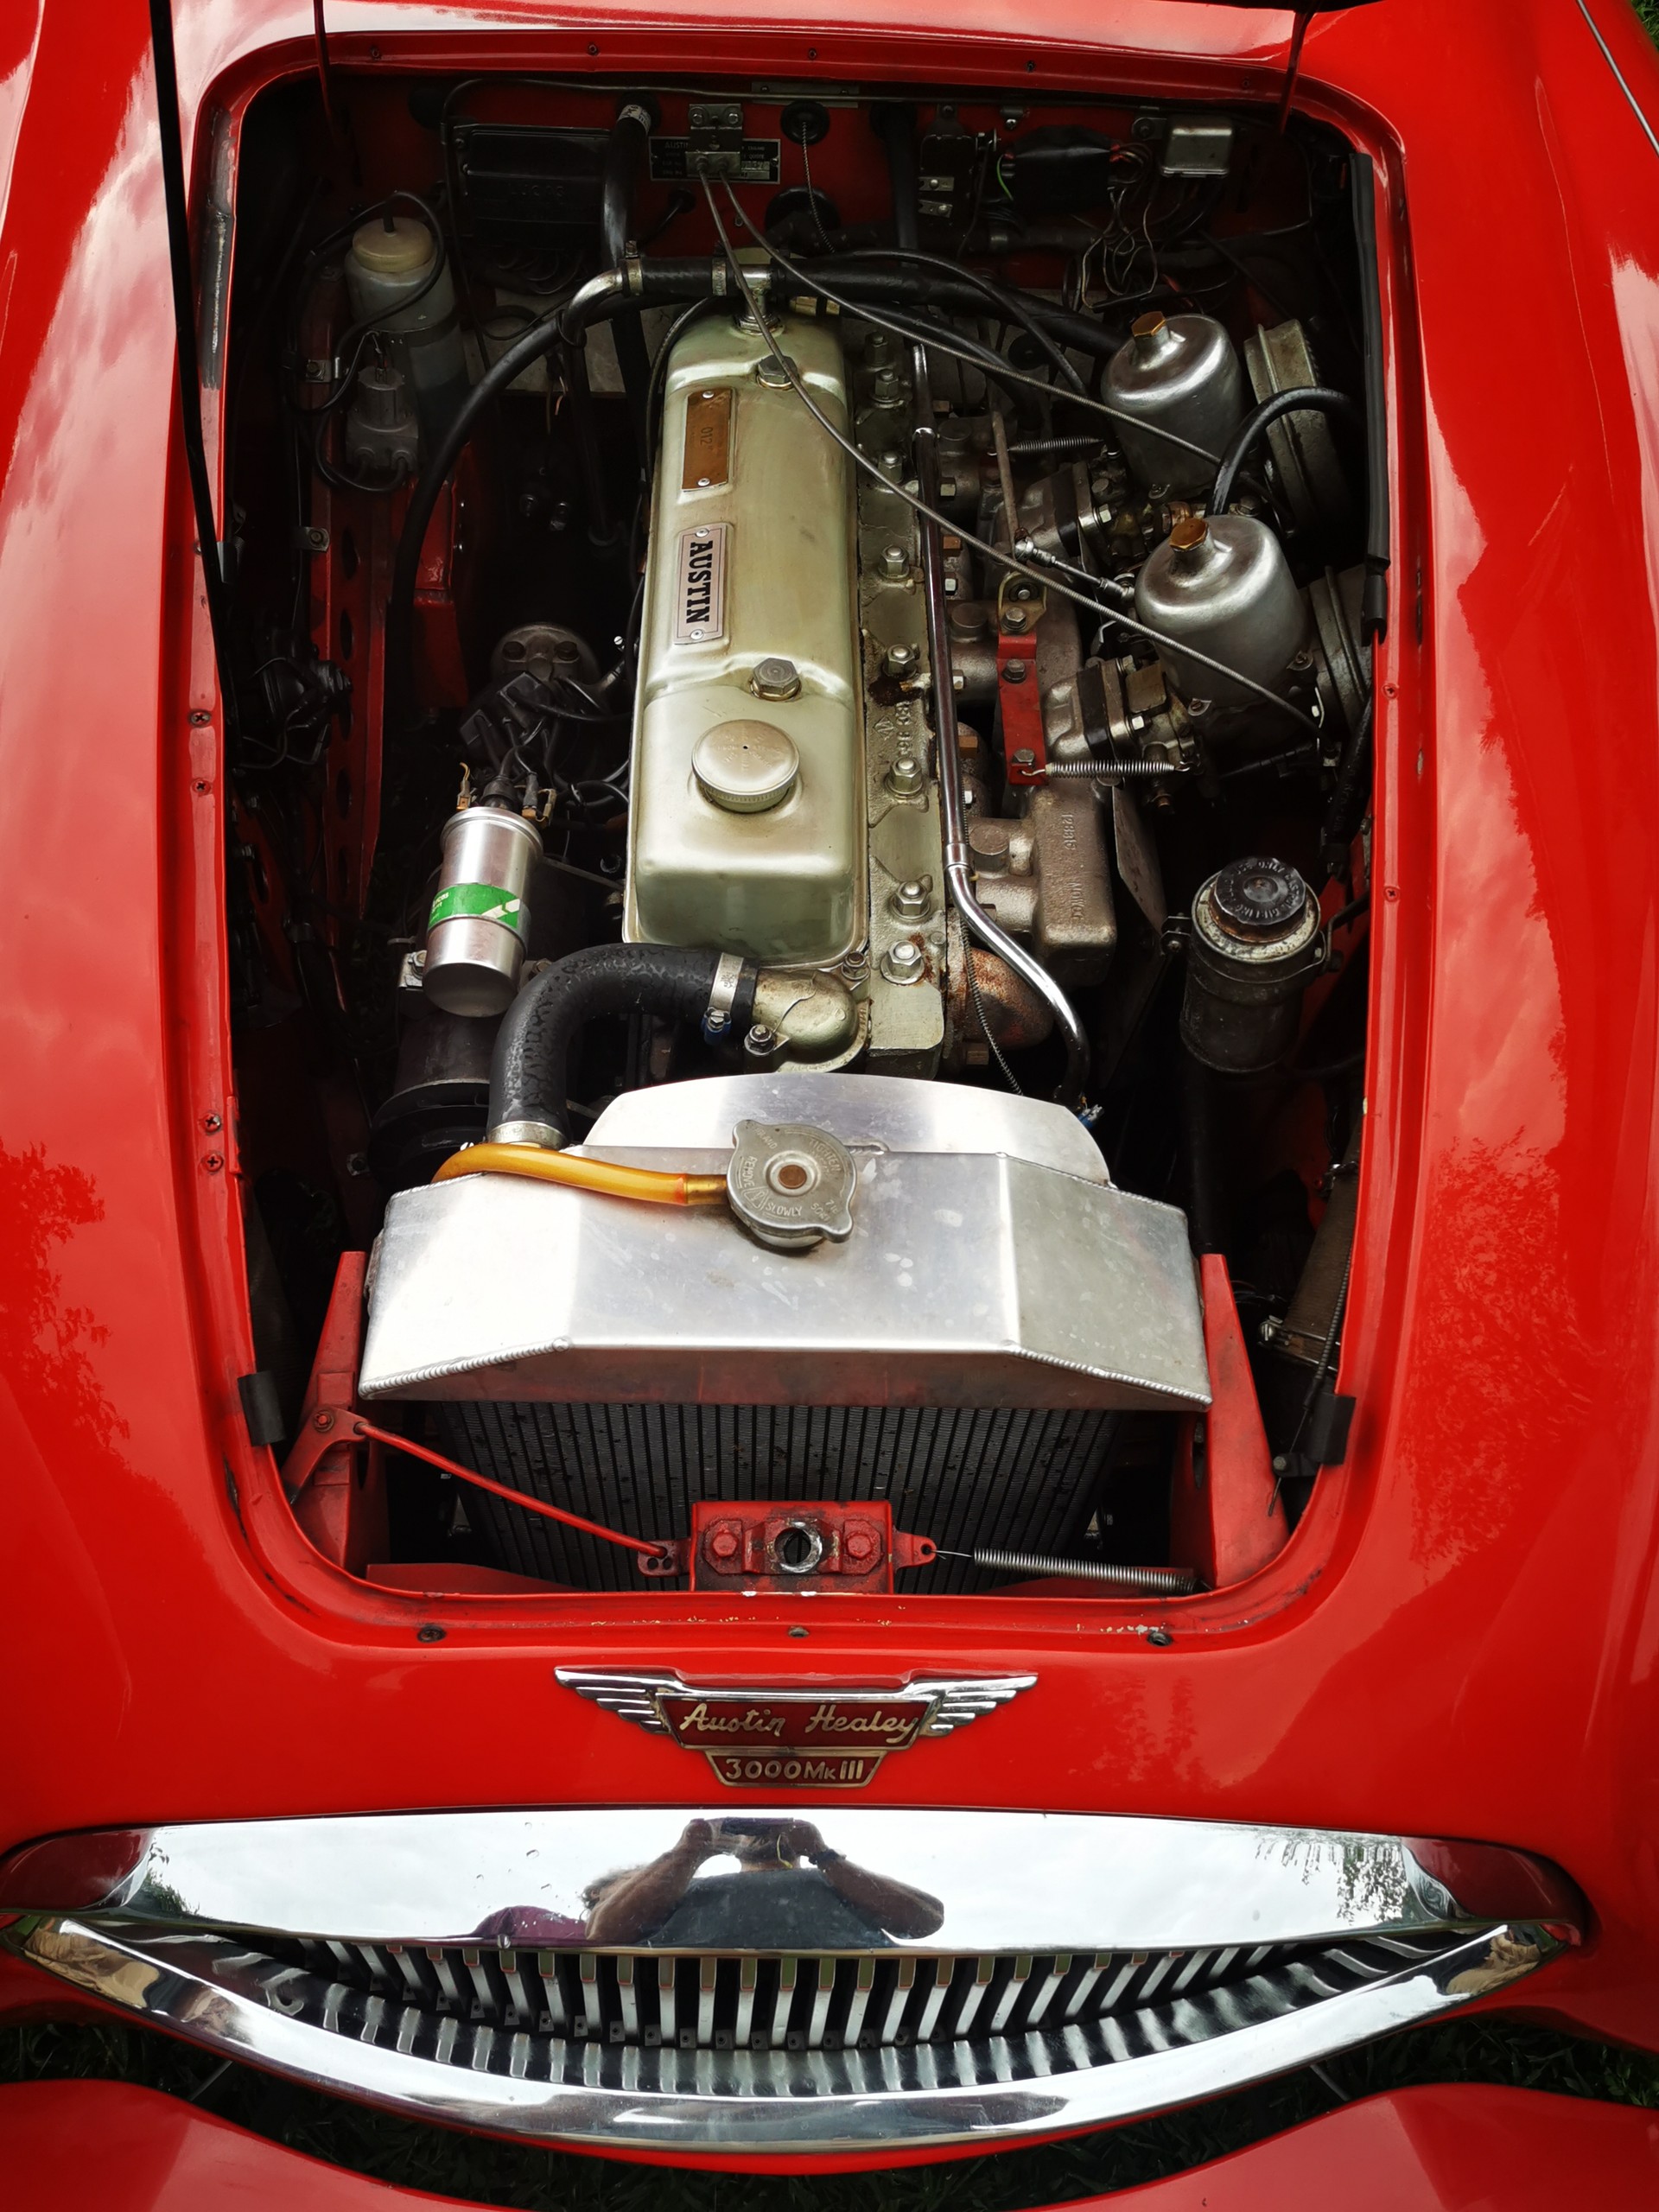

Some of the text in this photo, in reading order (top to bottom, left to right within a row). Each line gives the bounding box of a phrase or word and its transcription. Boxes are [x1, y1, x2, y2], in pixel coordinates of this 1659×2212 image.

[686, 541, 713, 624] AUSTIN
[1257, 861, 1286, 873] ONLY
[743, 1155, 759, 1188] REMOVE
[810, 1140, 842, 1172] TIGHTEN
[765, 1201, 803, 1217] SLOWLY
[679, 1703, 918, 1744] Austin Healey
